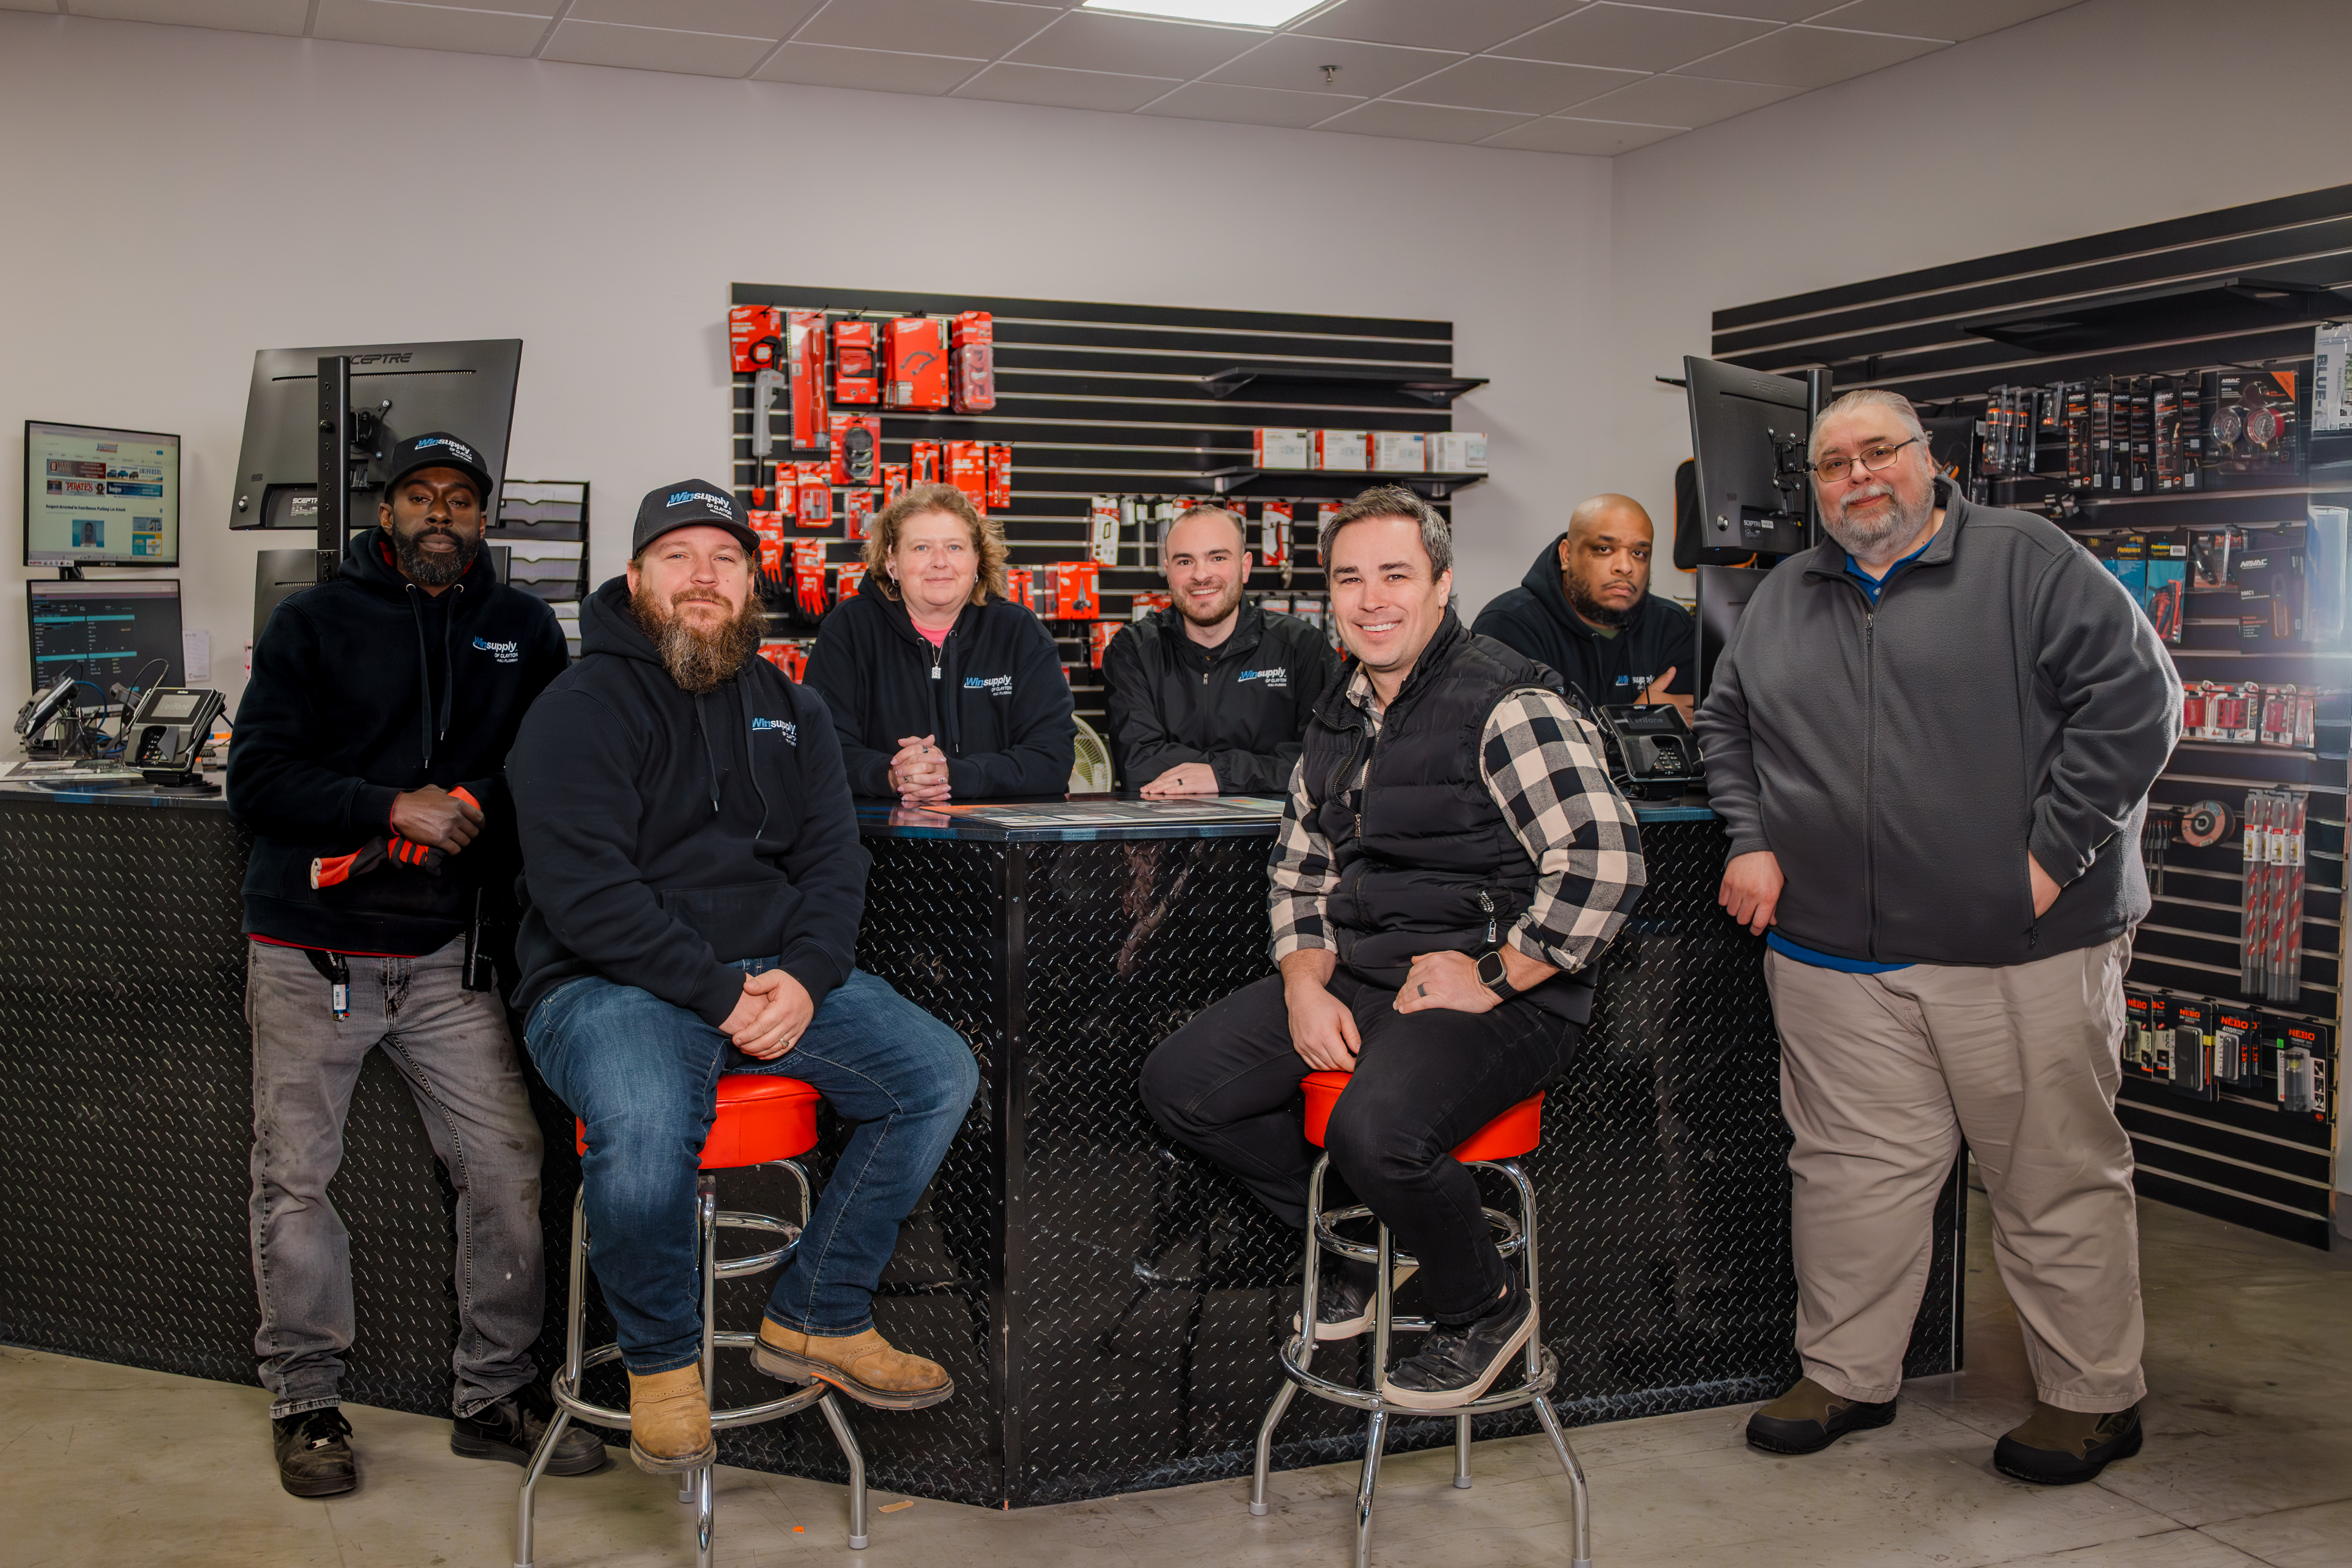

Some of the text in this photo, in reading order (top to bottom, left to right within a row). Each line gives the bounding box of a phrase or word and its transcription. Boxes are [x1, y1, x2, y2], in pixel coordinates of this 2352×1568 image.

[350, 352, 412, 365] CEPTRE
[418, 438, 470, 454] Winsupply
[455, 449, 472, 461] CLAYTON
[670, 492, 729, 508] Winsupply
[714, 505, 732, 516] CLAYTON
[2240, 559, 2267, 567] NAVAC
[474, 635, 517, 653] Winsupply
[1241, 667, 1286, 680] Winsupply
[966, 674, 1012, 687] Winsupply
[752, 718, 796, 735] Winsupply
[2180, 1008, 2200, 1018] NEBO
[2221, 1015, 2248, 1030] NEBO
[2288, 1028, 2315, 1041] NEBO
